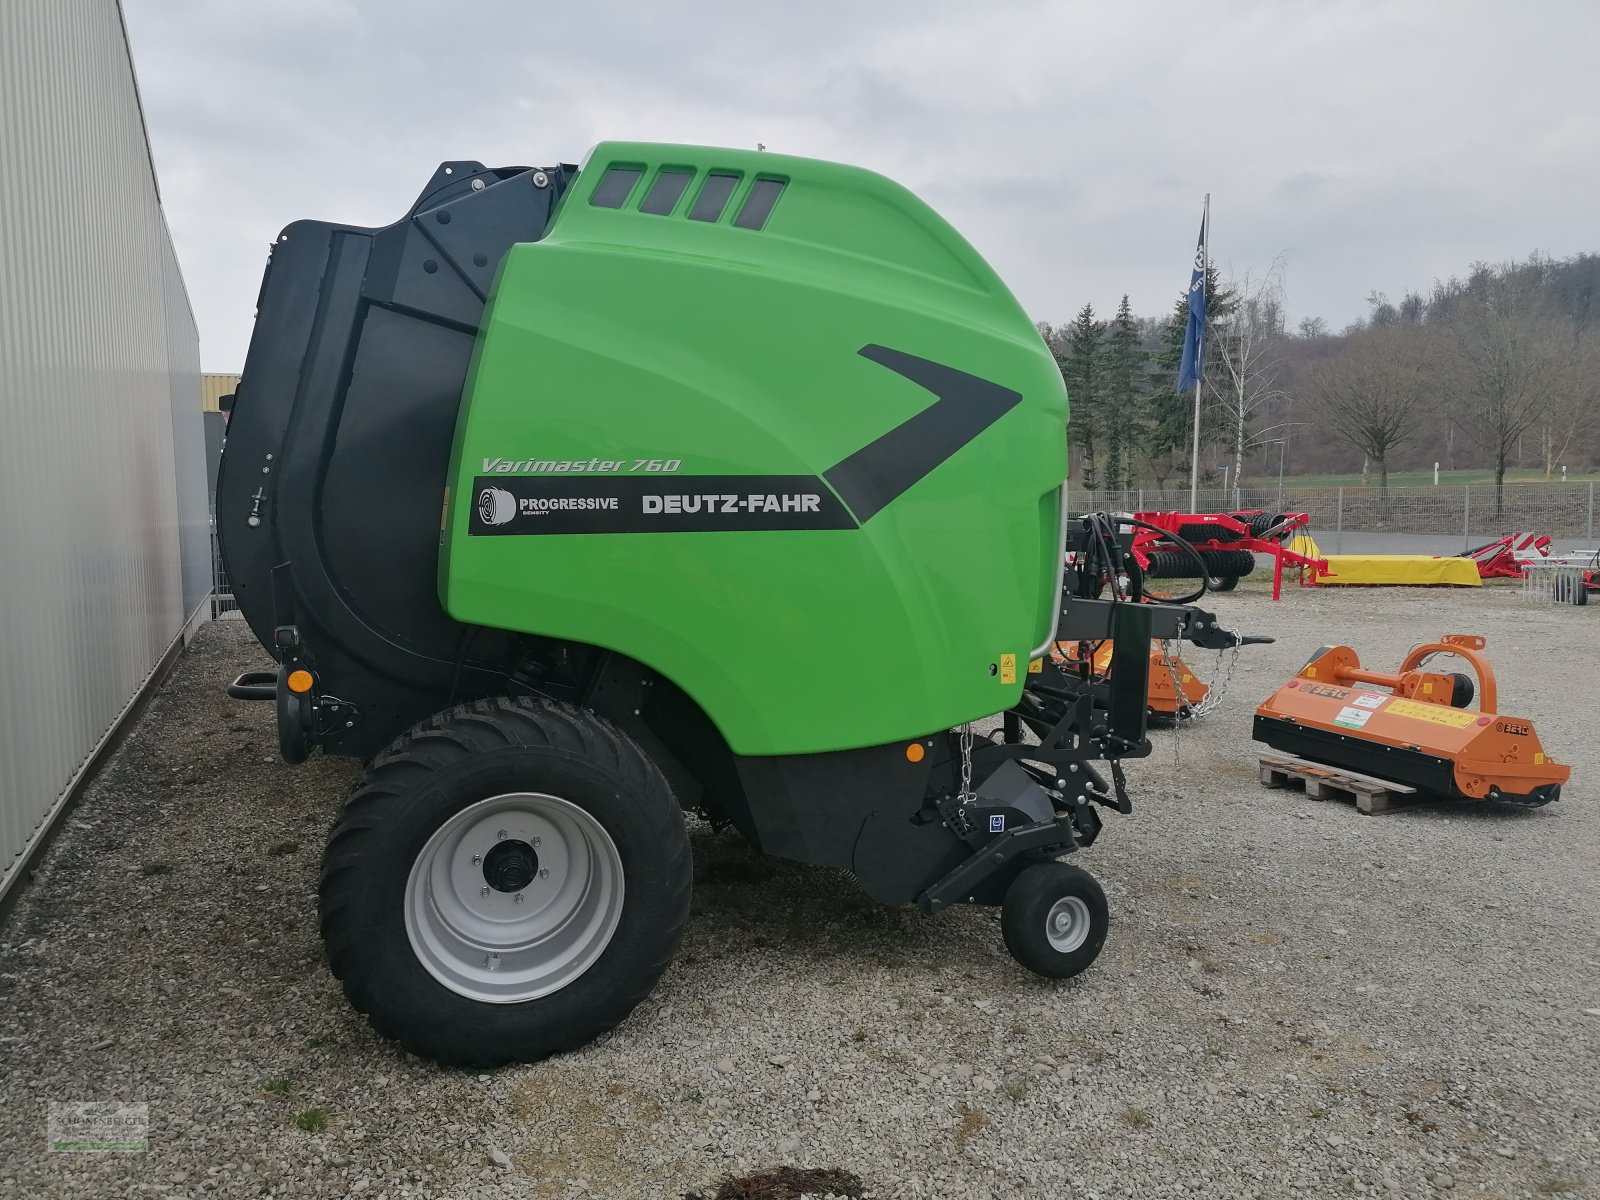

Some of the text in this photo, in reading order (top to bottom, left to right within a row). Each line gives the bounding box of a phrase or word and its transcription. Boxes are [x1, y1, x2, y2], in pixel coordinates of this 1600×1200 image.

[481, 457, 682, 473] Varimaster 760
[519, 497, 619, 511] PROGRESSIVE
[642, 494, 821, 514] DEUTZ-FAHR
